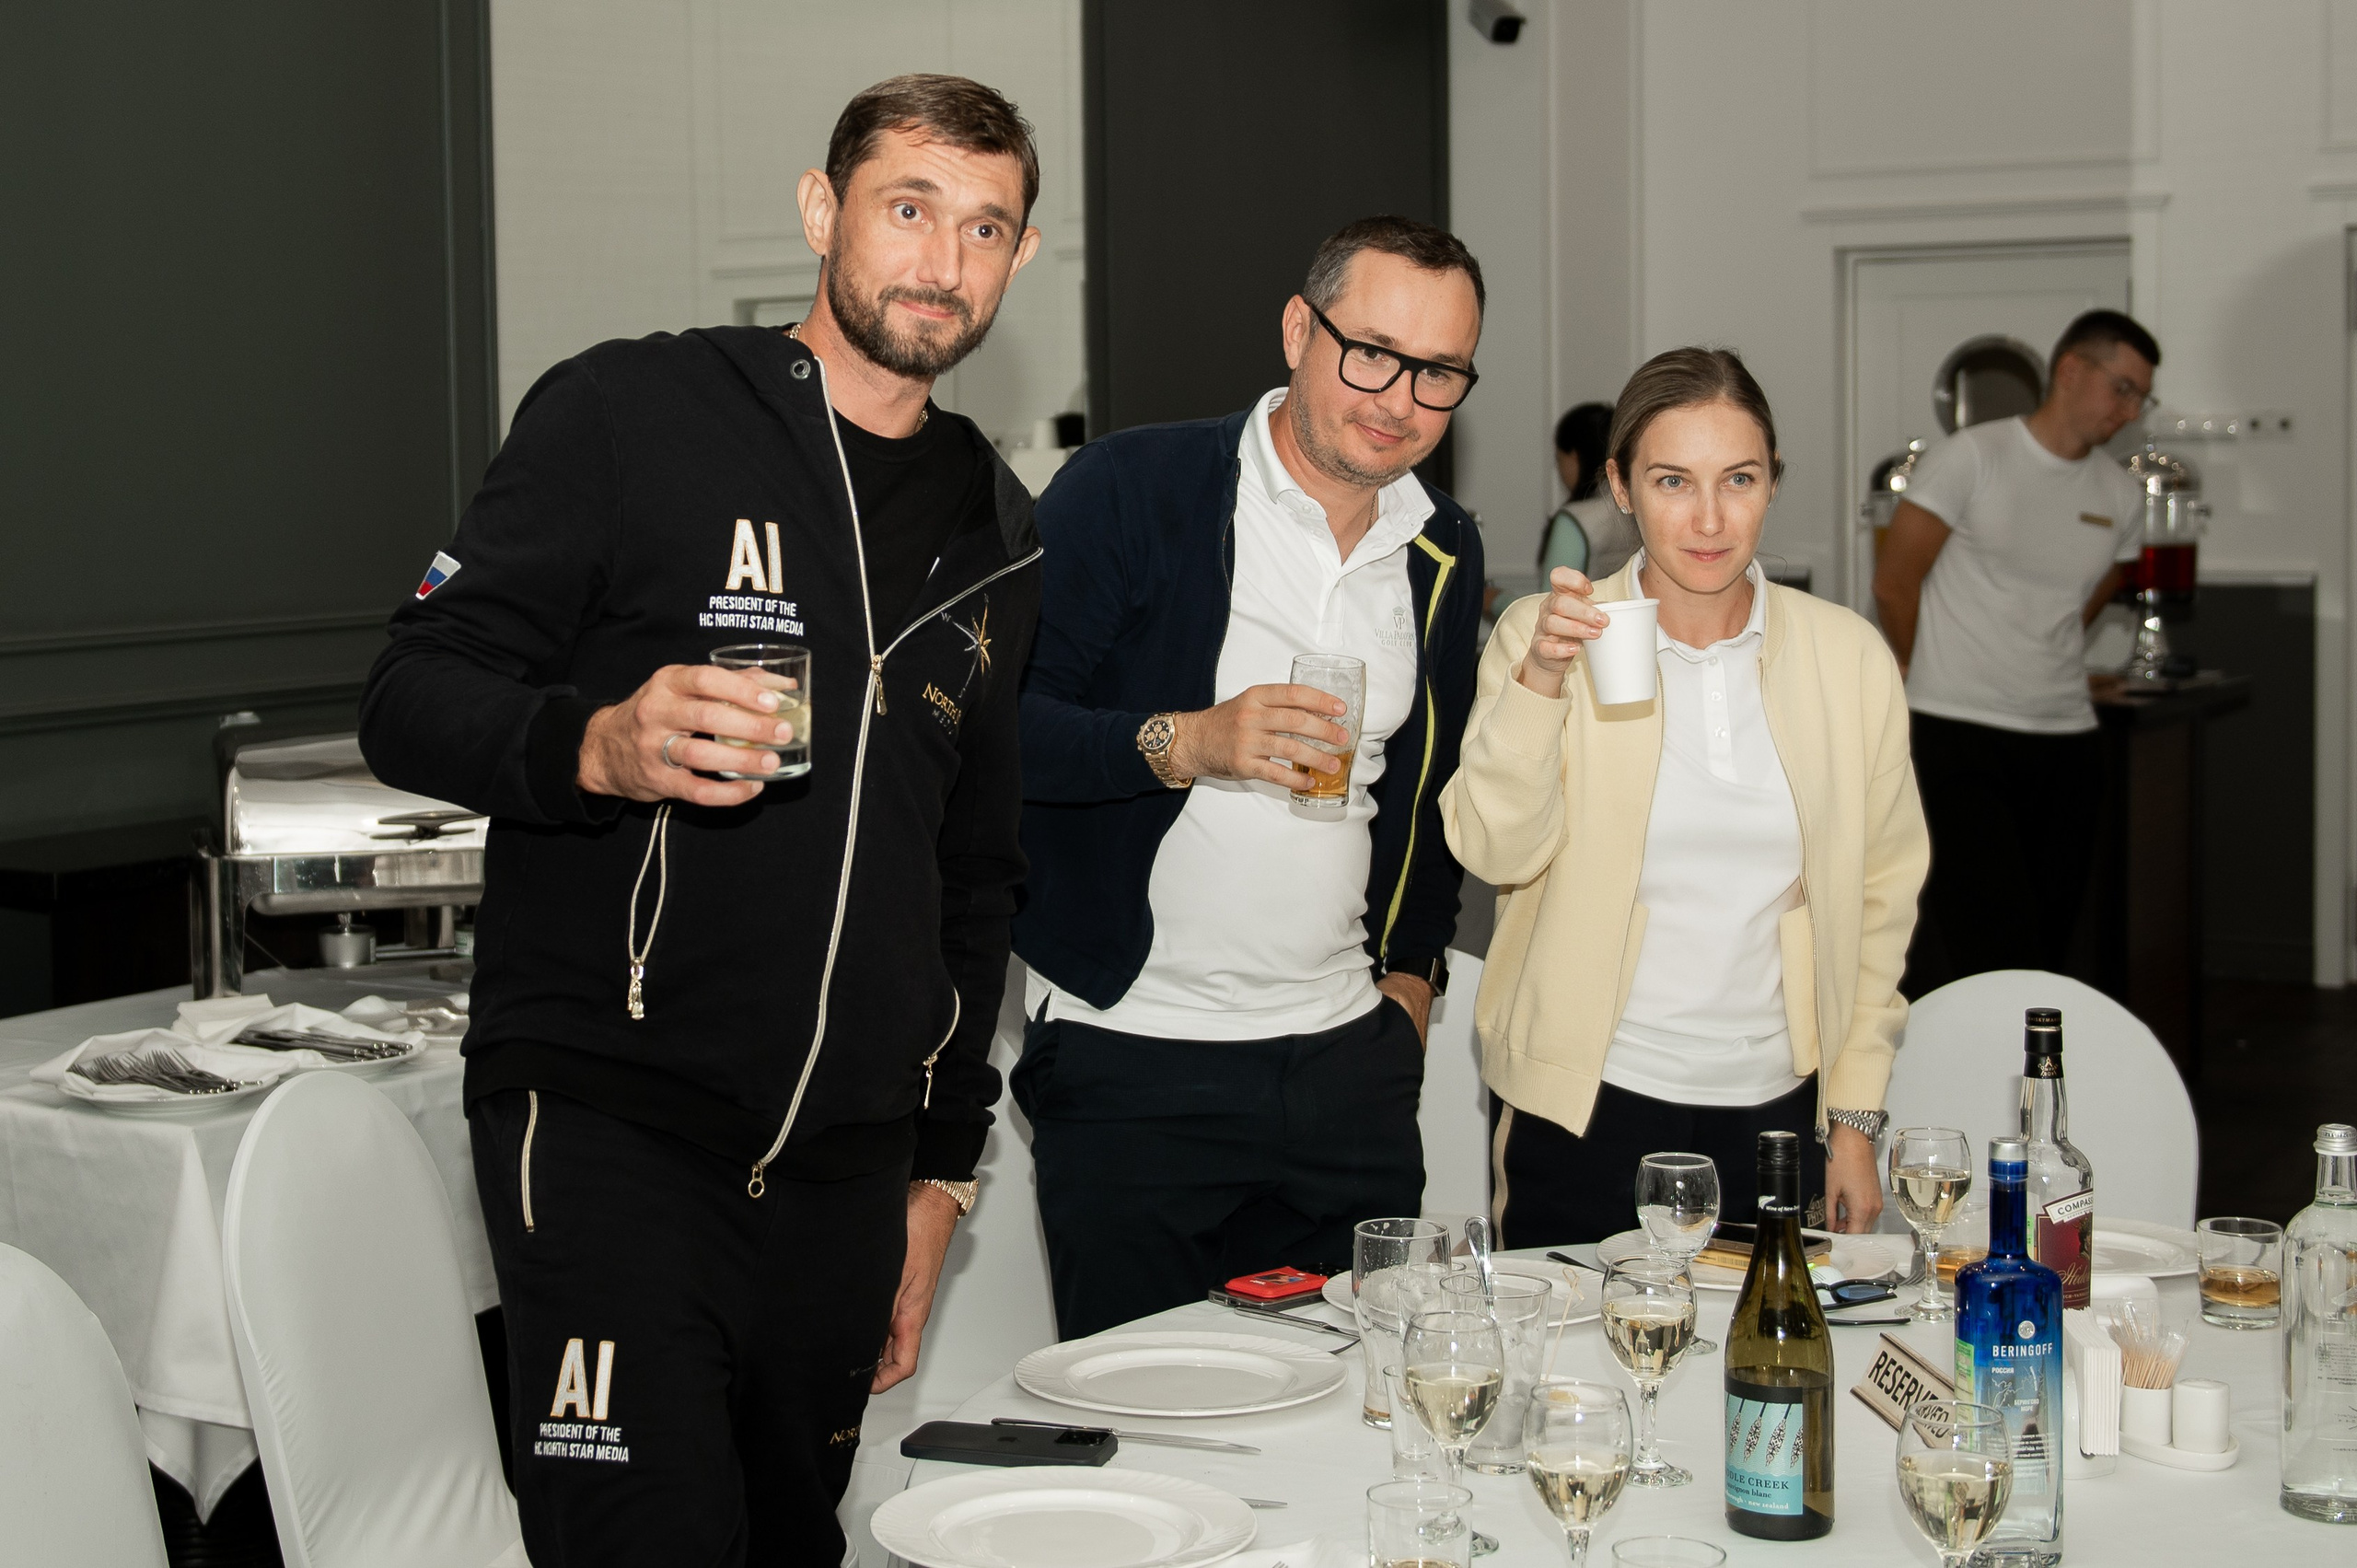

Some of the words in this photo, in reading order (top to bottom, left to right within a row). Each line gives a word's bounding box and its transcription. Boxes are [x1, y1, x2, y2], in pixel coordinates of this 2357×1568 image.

[726, 518, 784, 594] AI
[709, 595, 763, 612] PRESIDENT
[764, 599, 778, 613] OF
[778, 600, 797, 617] THE
[699, 612, 714, 627] HC
[714, 612, 748, 628] NORTH
[749, 615, 774, 631] STAR
[775, 618, 804, 636] MEDIA
[1992, 1342, 2052, 1357] BERINGOFF
[551, 1338, 615, 1420] AI
[540, 1422, 584, 1440] PRESIDENT
[585, 1424, 599, 1440] OF
[599, 1426, 621, 1443] THE
[830, 1424, 862, 1445] NOR
[569, 1443, 595, 1458] STAR
[595, 1444, 629, 1462] MEDIA
[1726, 1481, 1750, 1495] auvignon
[1751, 1489, 1772, 1499] blanc
[1747, 1477, 1789, 1490] CREEK
[1762, 1502, 1789, 1510] zealand
